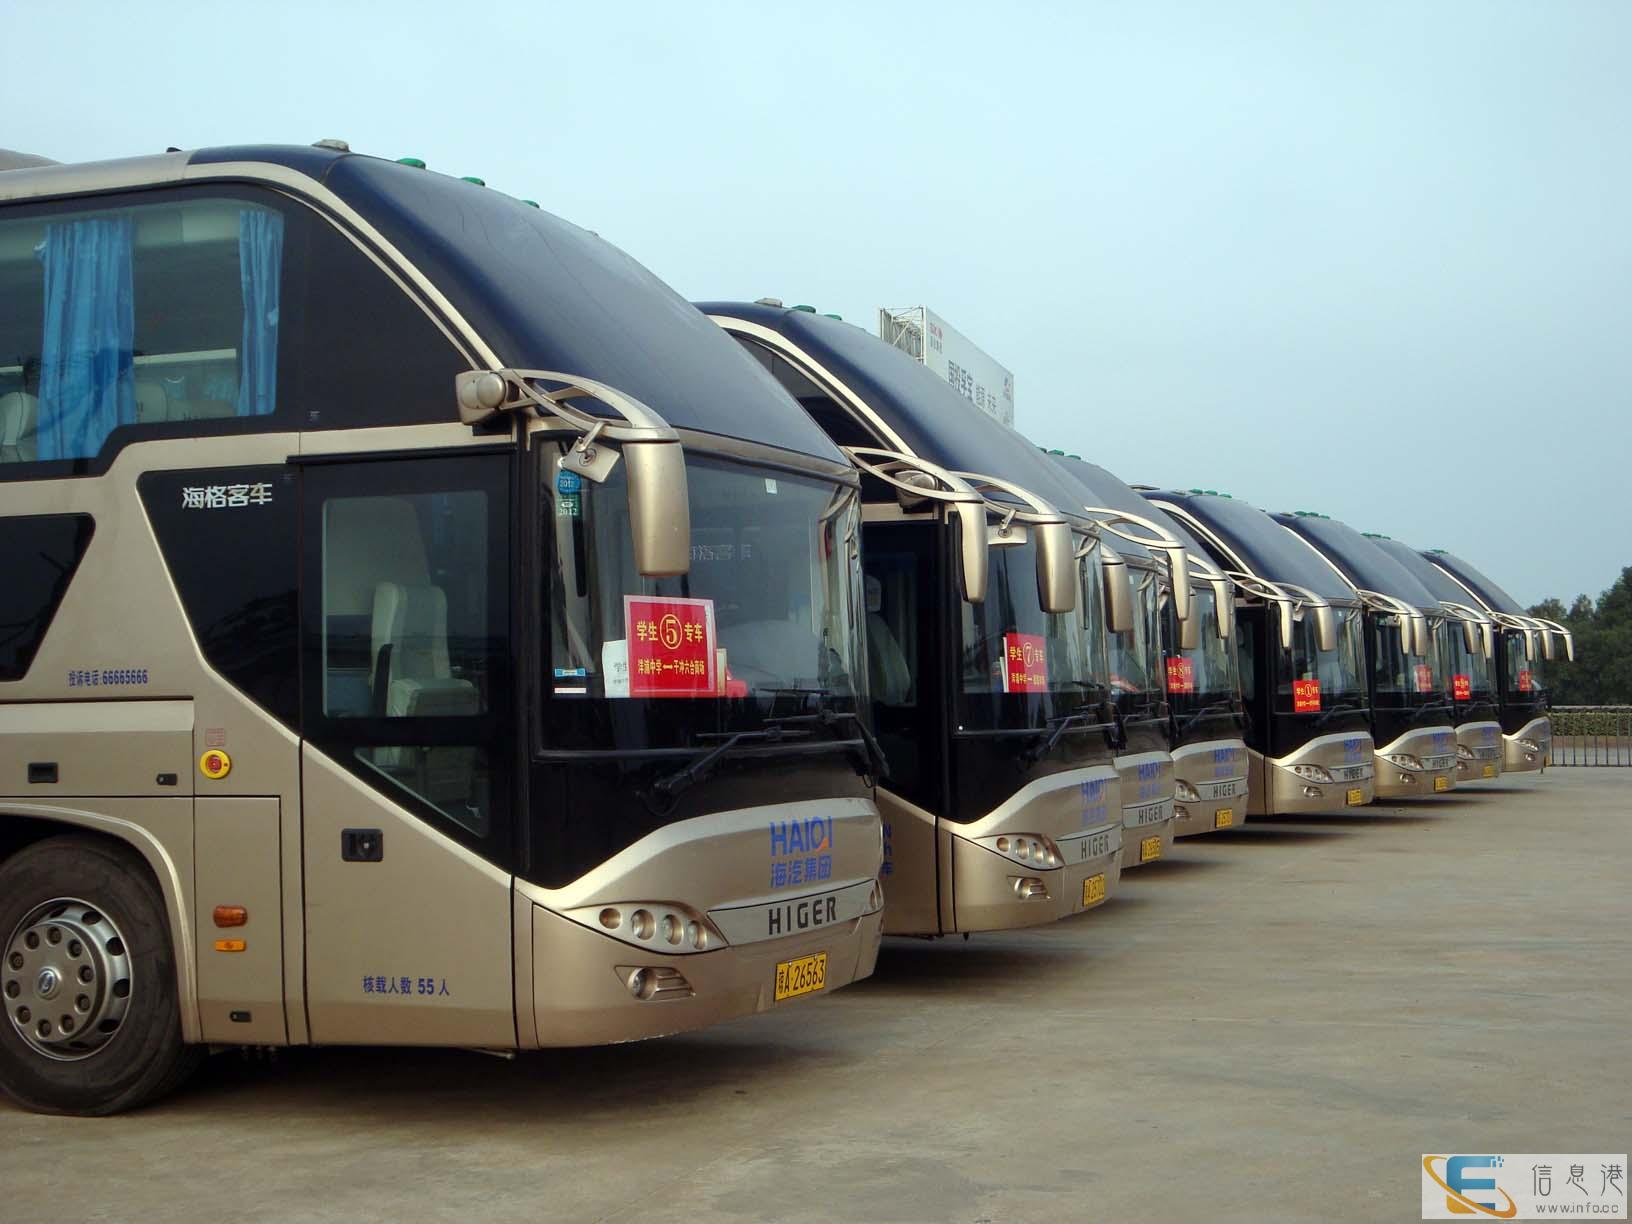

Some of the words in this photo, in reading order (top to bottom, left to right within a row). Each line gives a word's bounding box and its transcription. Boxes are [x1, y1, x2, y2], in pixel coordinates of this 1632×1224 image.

[182, 482, 273, 509] 海格客车
[636, 620, 658, 641] 学生
[684, 622, 703, 643] 专车
[770, 854, 833, 889] 海汽集团
[768, 896, 837, 935] HIGER
[362, 976, 412, 994] 核载人数
[418, 978, 434, 995] 55
[439, 979, 450, 996] 人
